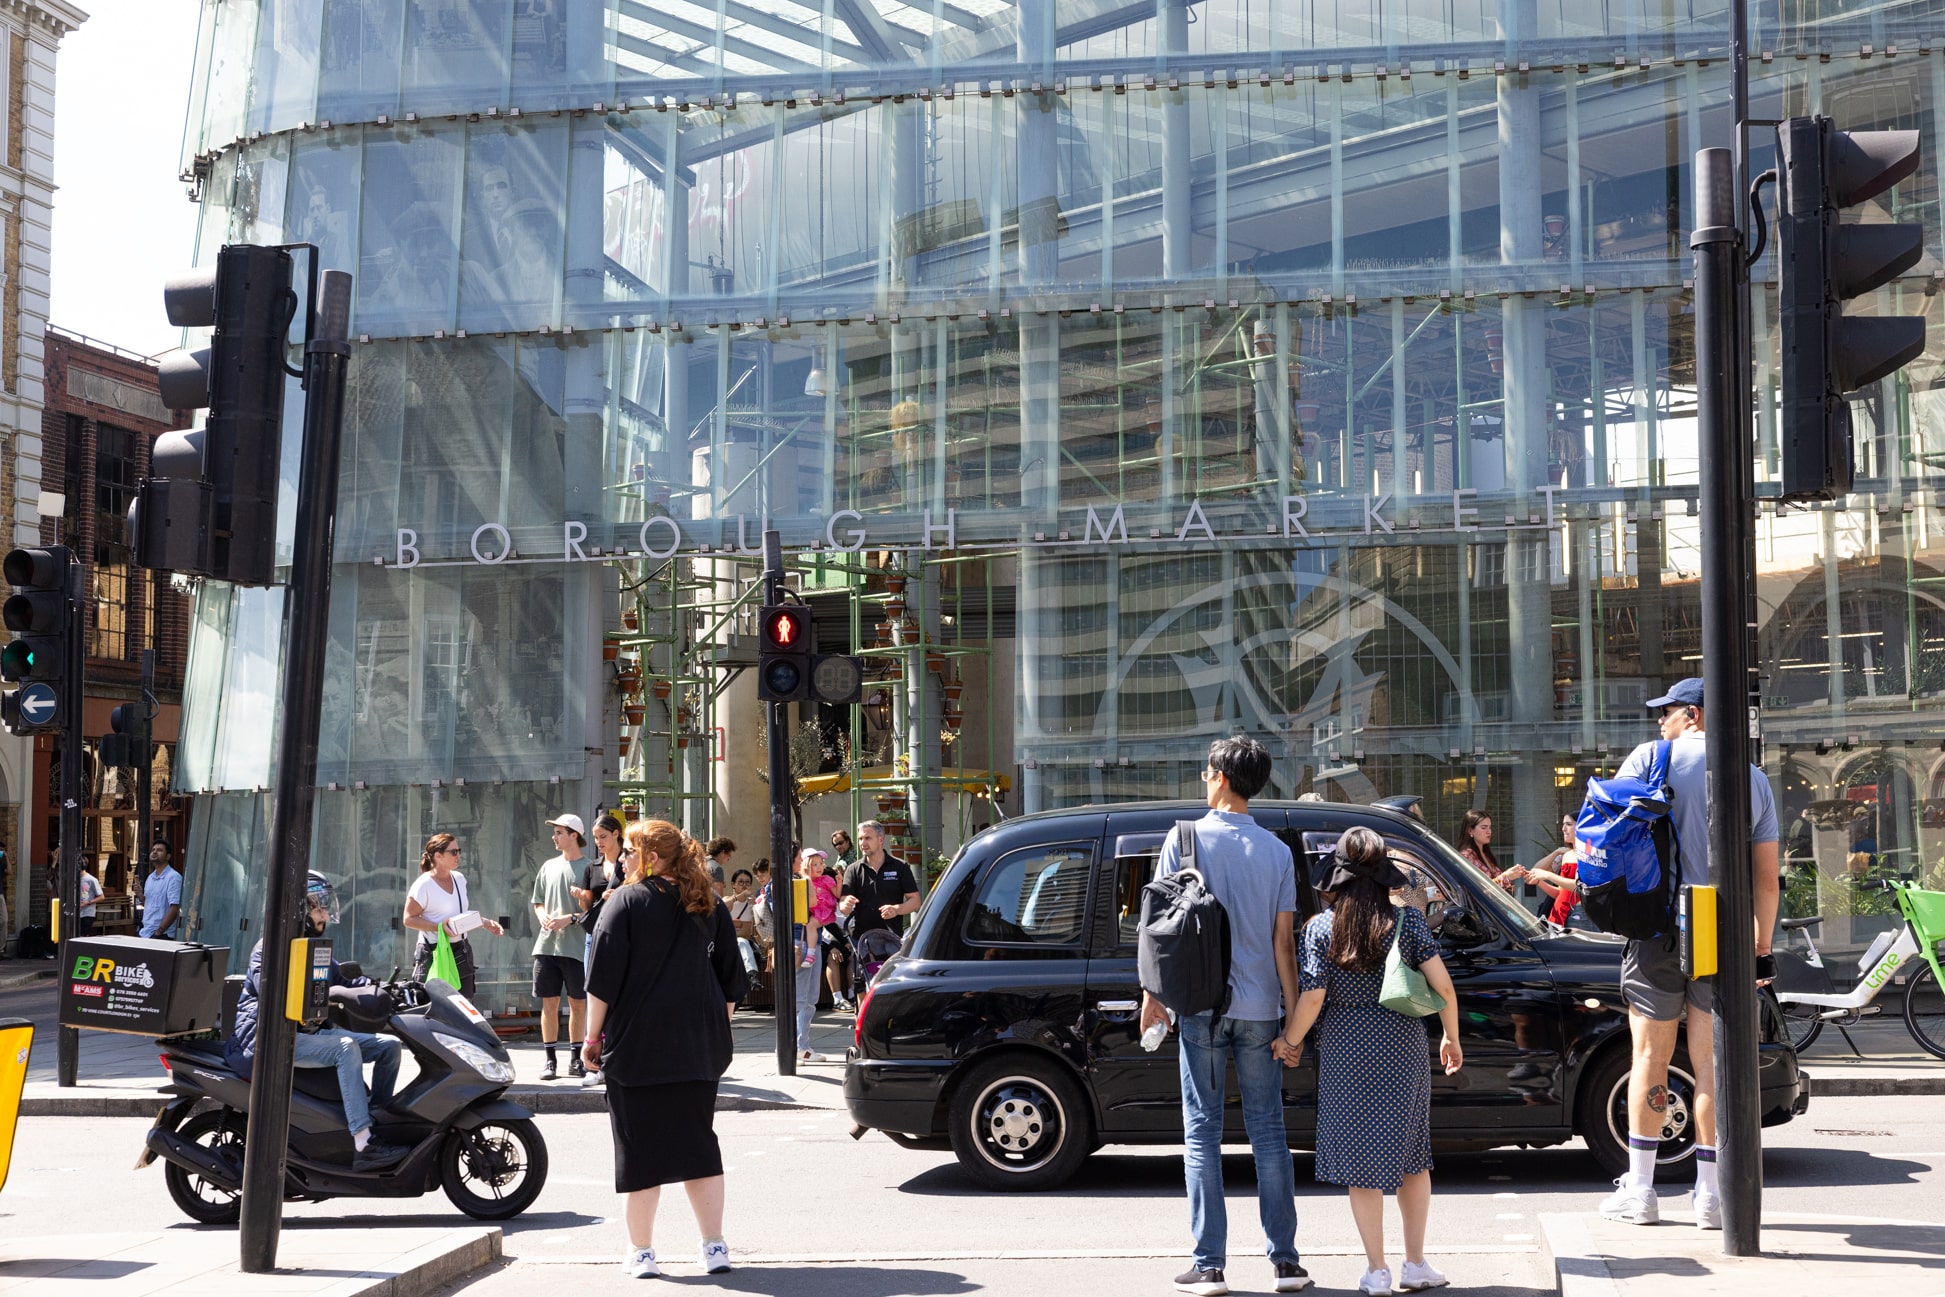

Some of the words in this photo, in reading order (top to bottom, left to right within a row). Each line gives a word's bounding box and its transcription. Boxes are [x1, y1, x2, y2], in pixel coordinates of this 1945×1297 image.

[397, 508, 956, 568] BOROUGH
[1083, 485, 1562, 545] MARKET
[72, 955, 116, 983] BR
[115, 965, 144, 978] BIKE
[313, 967, 329, 980] WAIT
